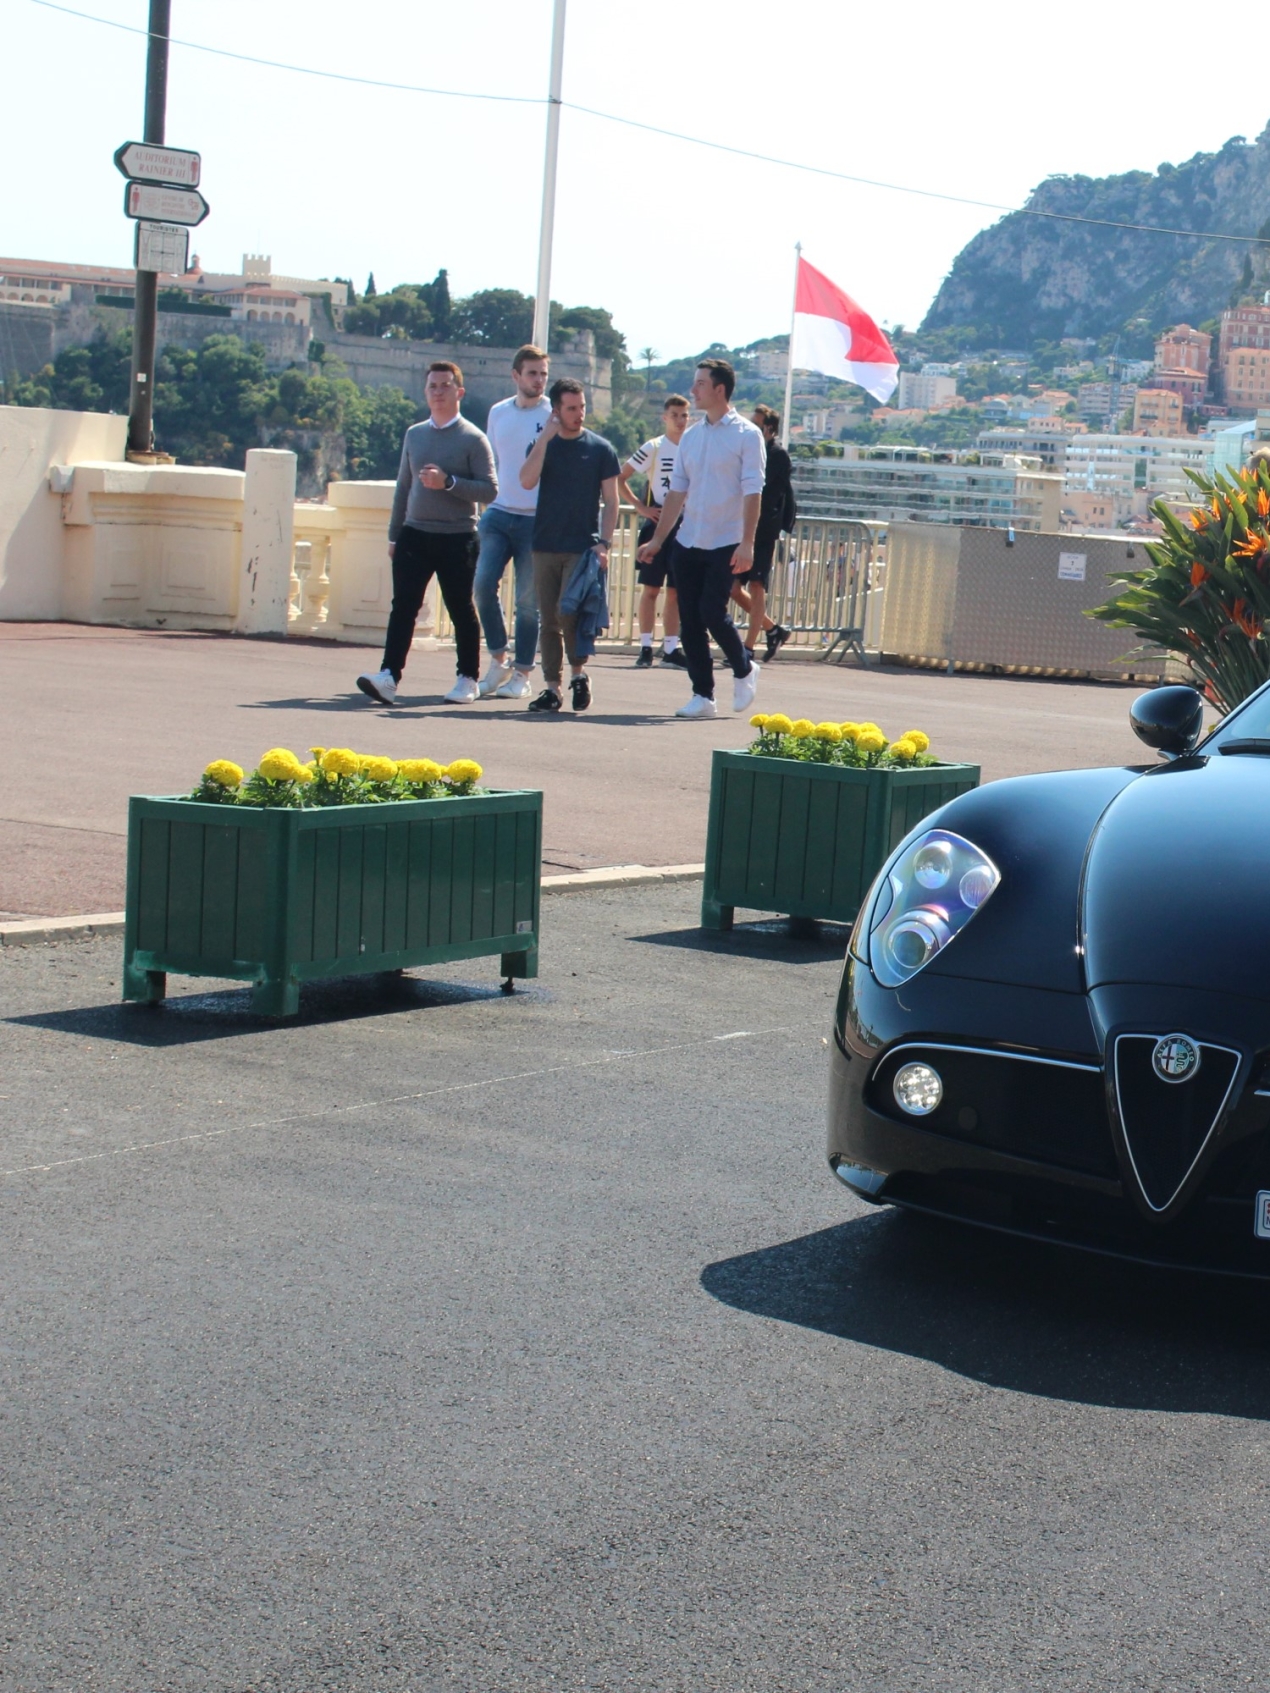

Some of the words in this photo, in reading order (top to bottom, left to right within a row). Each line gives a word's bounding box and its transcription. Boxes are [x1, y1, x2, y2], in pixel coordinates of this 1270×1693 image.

[134, 151, 187, 168] AUDITORIUM
[138, 163, 174, 177] RAINIER
[1157, 1040, 1173, 1058] ALFA
[1176, 1039, 1195, 1062] ROMEO
